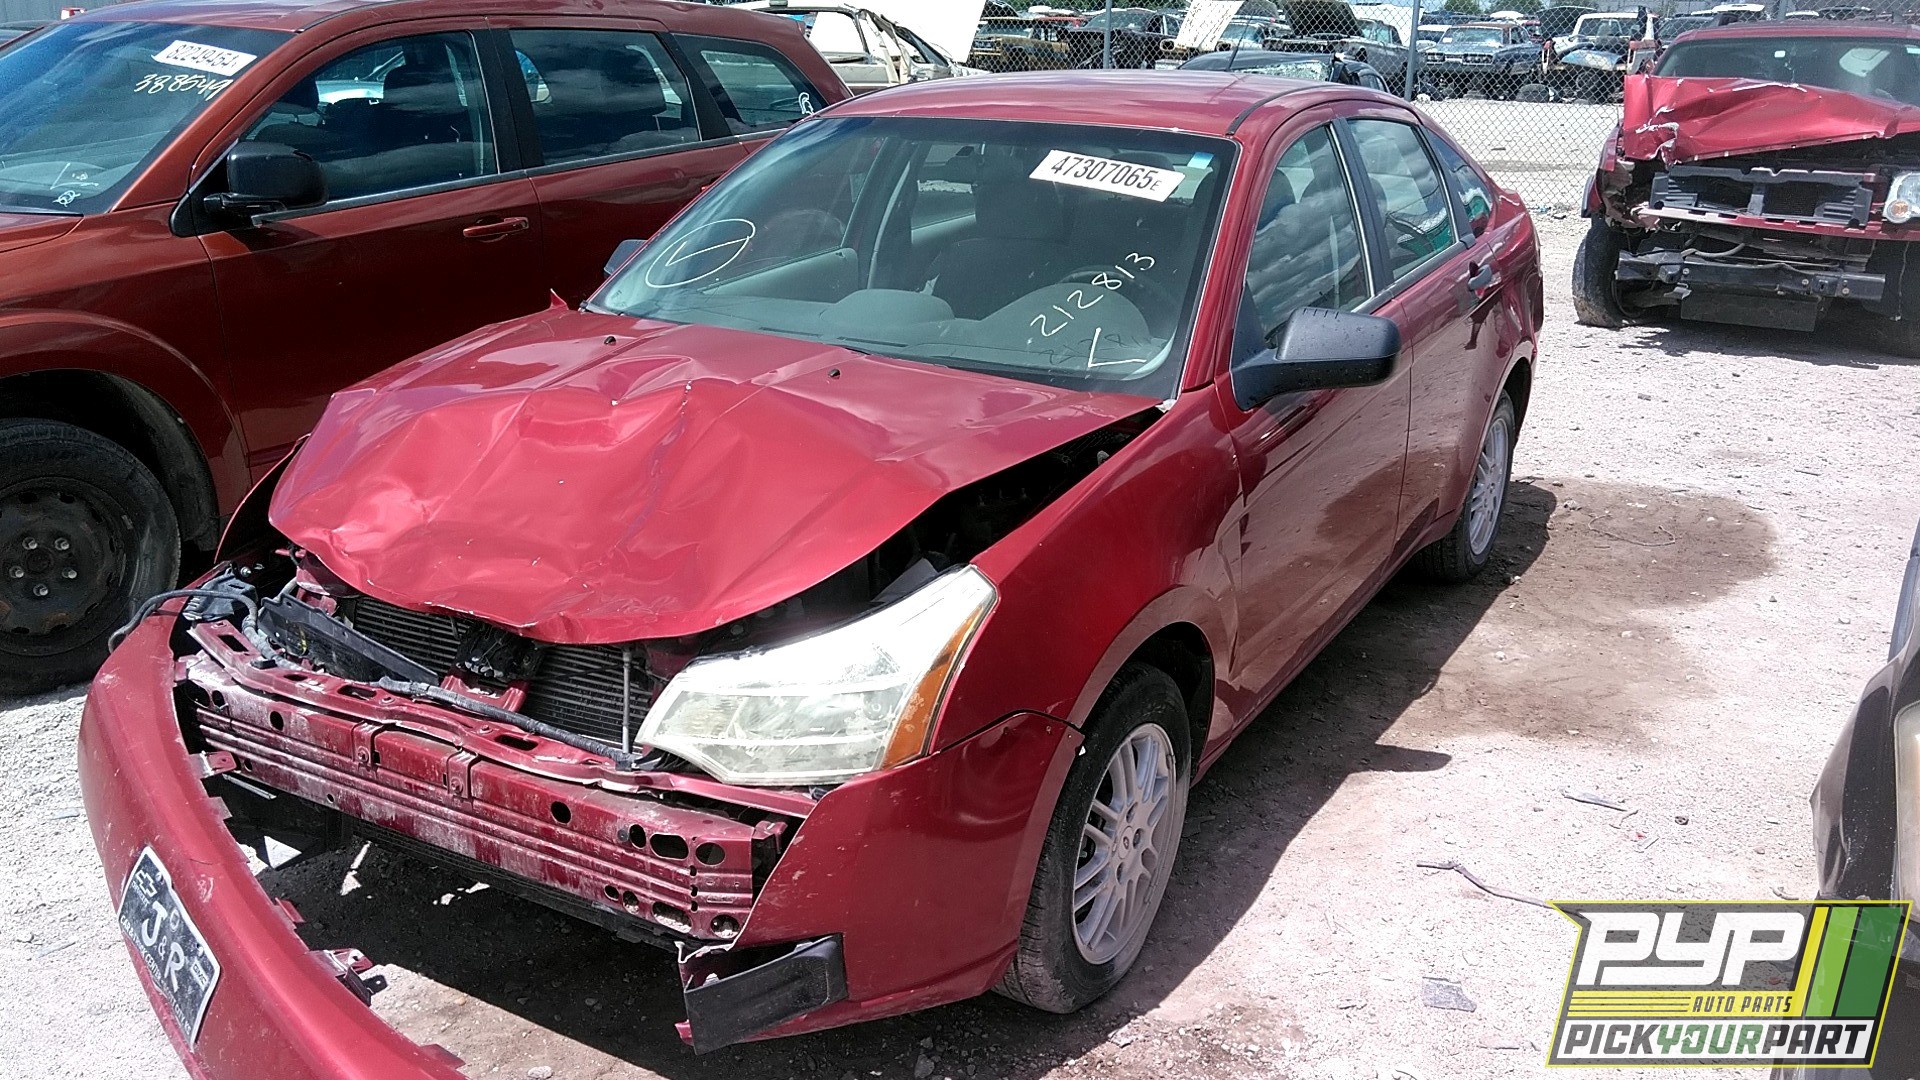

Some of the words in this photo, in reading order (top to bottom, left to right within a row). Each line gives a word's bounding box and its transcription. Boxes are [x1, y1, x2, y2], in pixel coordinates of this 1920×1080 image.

[133, 73, 234, 102] 388549
[1029, 251, 1156, 338] 212813
[142, 900, 168, 947] J
[158, 935, 167, 960] &
[164, 942, 184, 993] R
